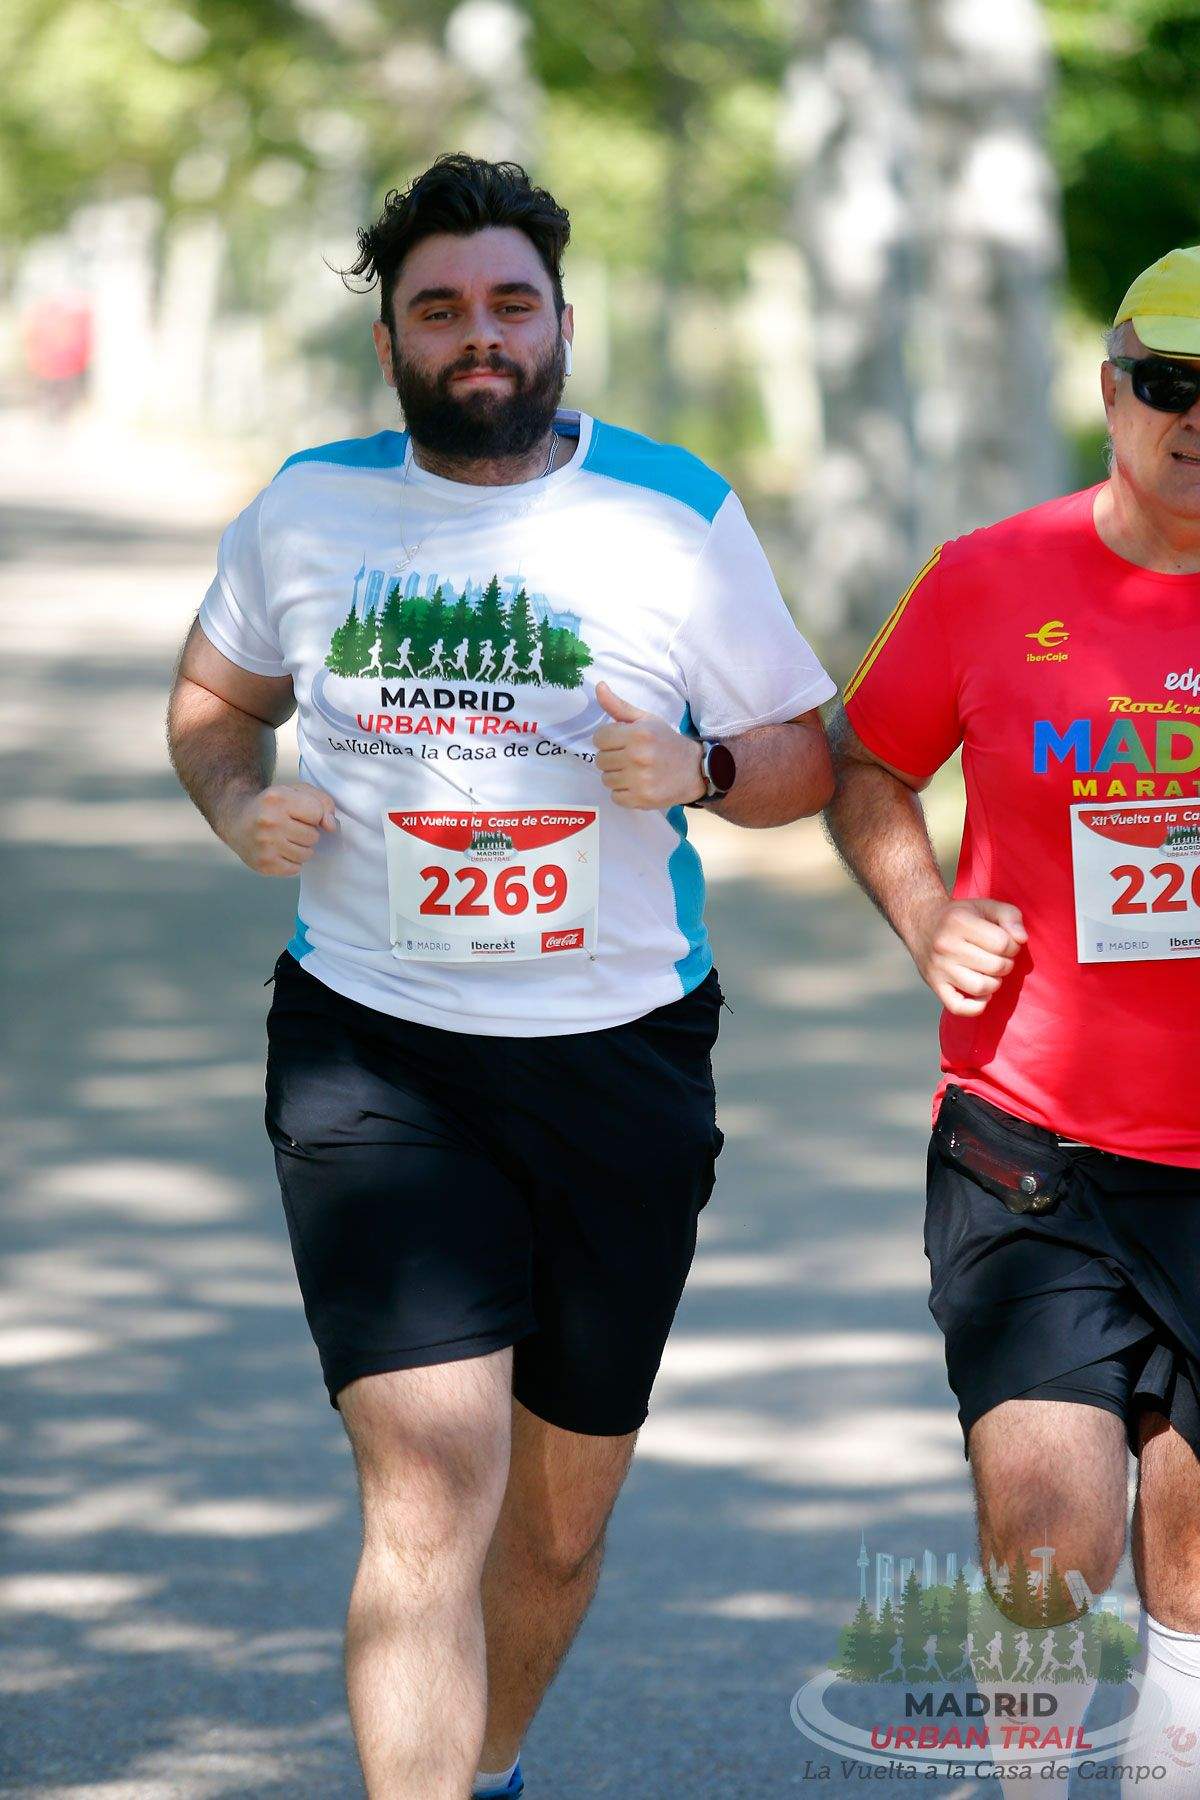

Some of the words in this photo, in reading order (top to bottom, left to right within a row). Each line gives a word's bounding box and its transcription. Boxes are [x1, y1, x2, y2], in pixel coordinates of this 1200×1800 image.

[381, 687, 515, 713] MADRID
[1107, 696, 1182, 714] Rock
[356, 714, 456, 735] URBAN
[346, 739, 402, 755] Vuelta
[421, 744, 438, 760] la
[446, 744, 497, 761] Casa
[503, 742, 529, 758] de
[1033, 719, 1200, 773] MAD
[402, 817, 417, 826] XII
[421, 816, 457, 826] Vuelta
[471, 817, 482, 827] la
[488, 818, 519, 827] Casa
[522, 816, 537, 826] de
[541, 815, 585, 826] Campo
[1110, 813, 1150, 825] Vuelta
[1153, 815, 1161, 823] a
[1165, 812, 1177, 822] la
[1183, 811, 1200, 821] Ca
[419, 864, 568, 916] 2269
[1110, 863, 1200, 915] 22
[417, 942, 450, 951] MADRID
[1109, 942, 1149, 950] MADRID
